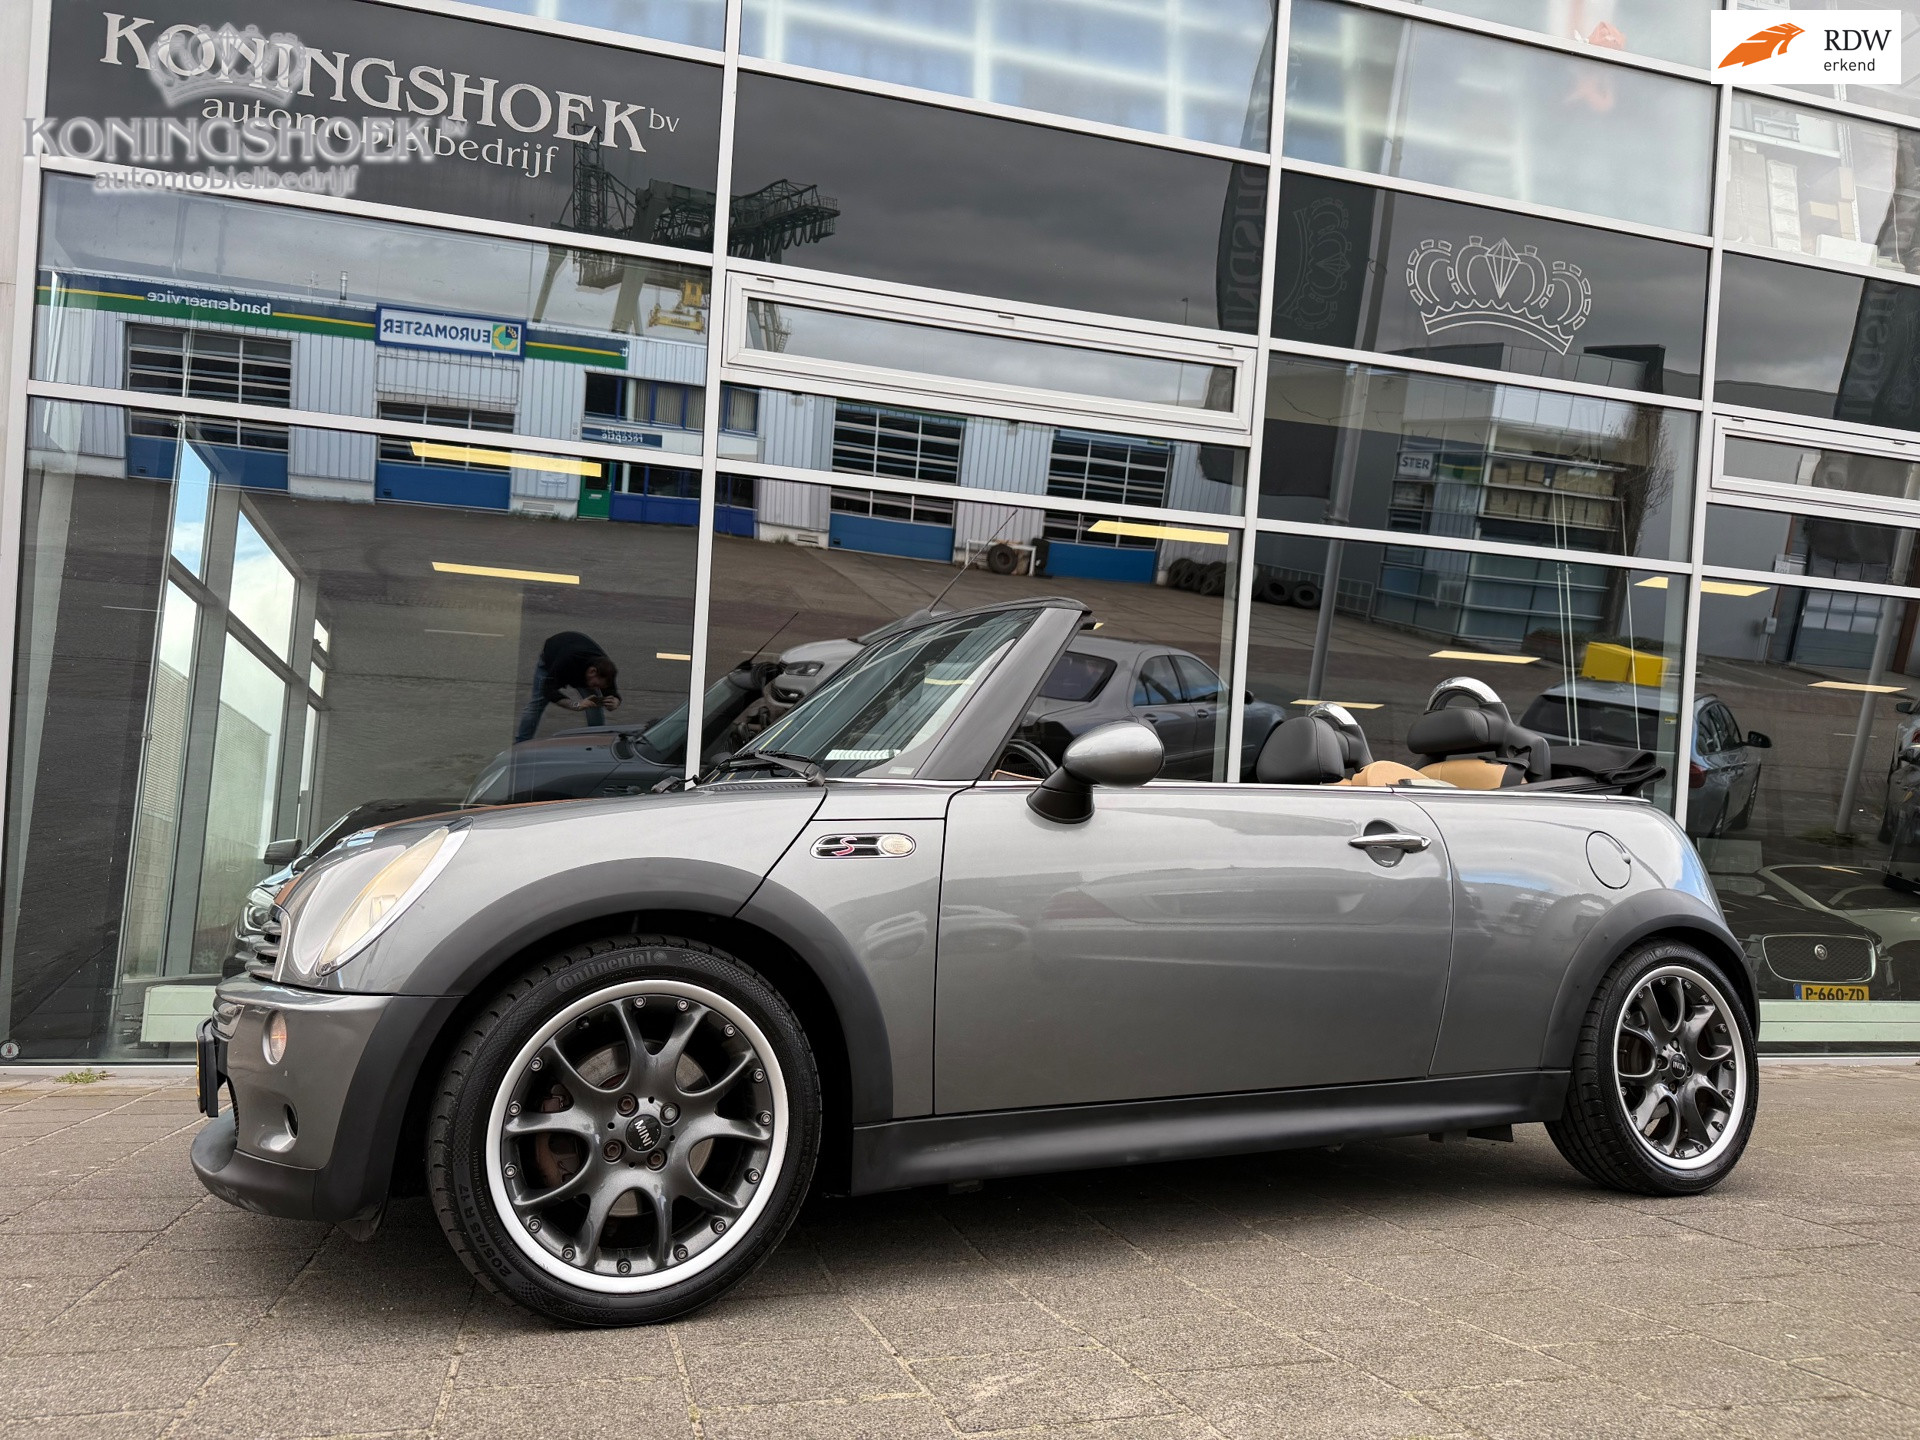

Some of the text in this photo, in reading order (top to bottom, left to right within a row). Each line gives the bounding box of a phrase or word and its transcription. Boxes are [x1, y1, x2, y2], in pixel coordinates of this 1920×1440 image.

[100, 12, 680, 153] KONINGSHOEK bv
[201, 96, 560, 178] automobielbedrijf
[555, 950, 652, 993] Continental
[1805, 986, 1865, 1001] P-660-ZD
[634, 1119, 653, 1147] MINI
